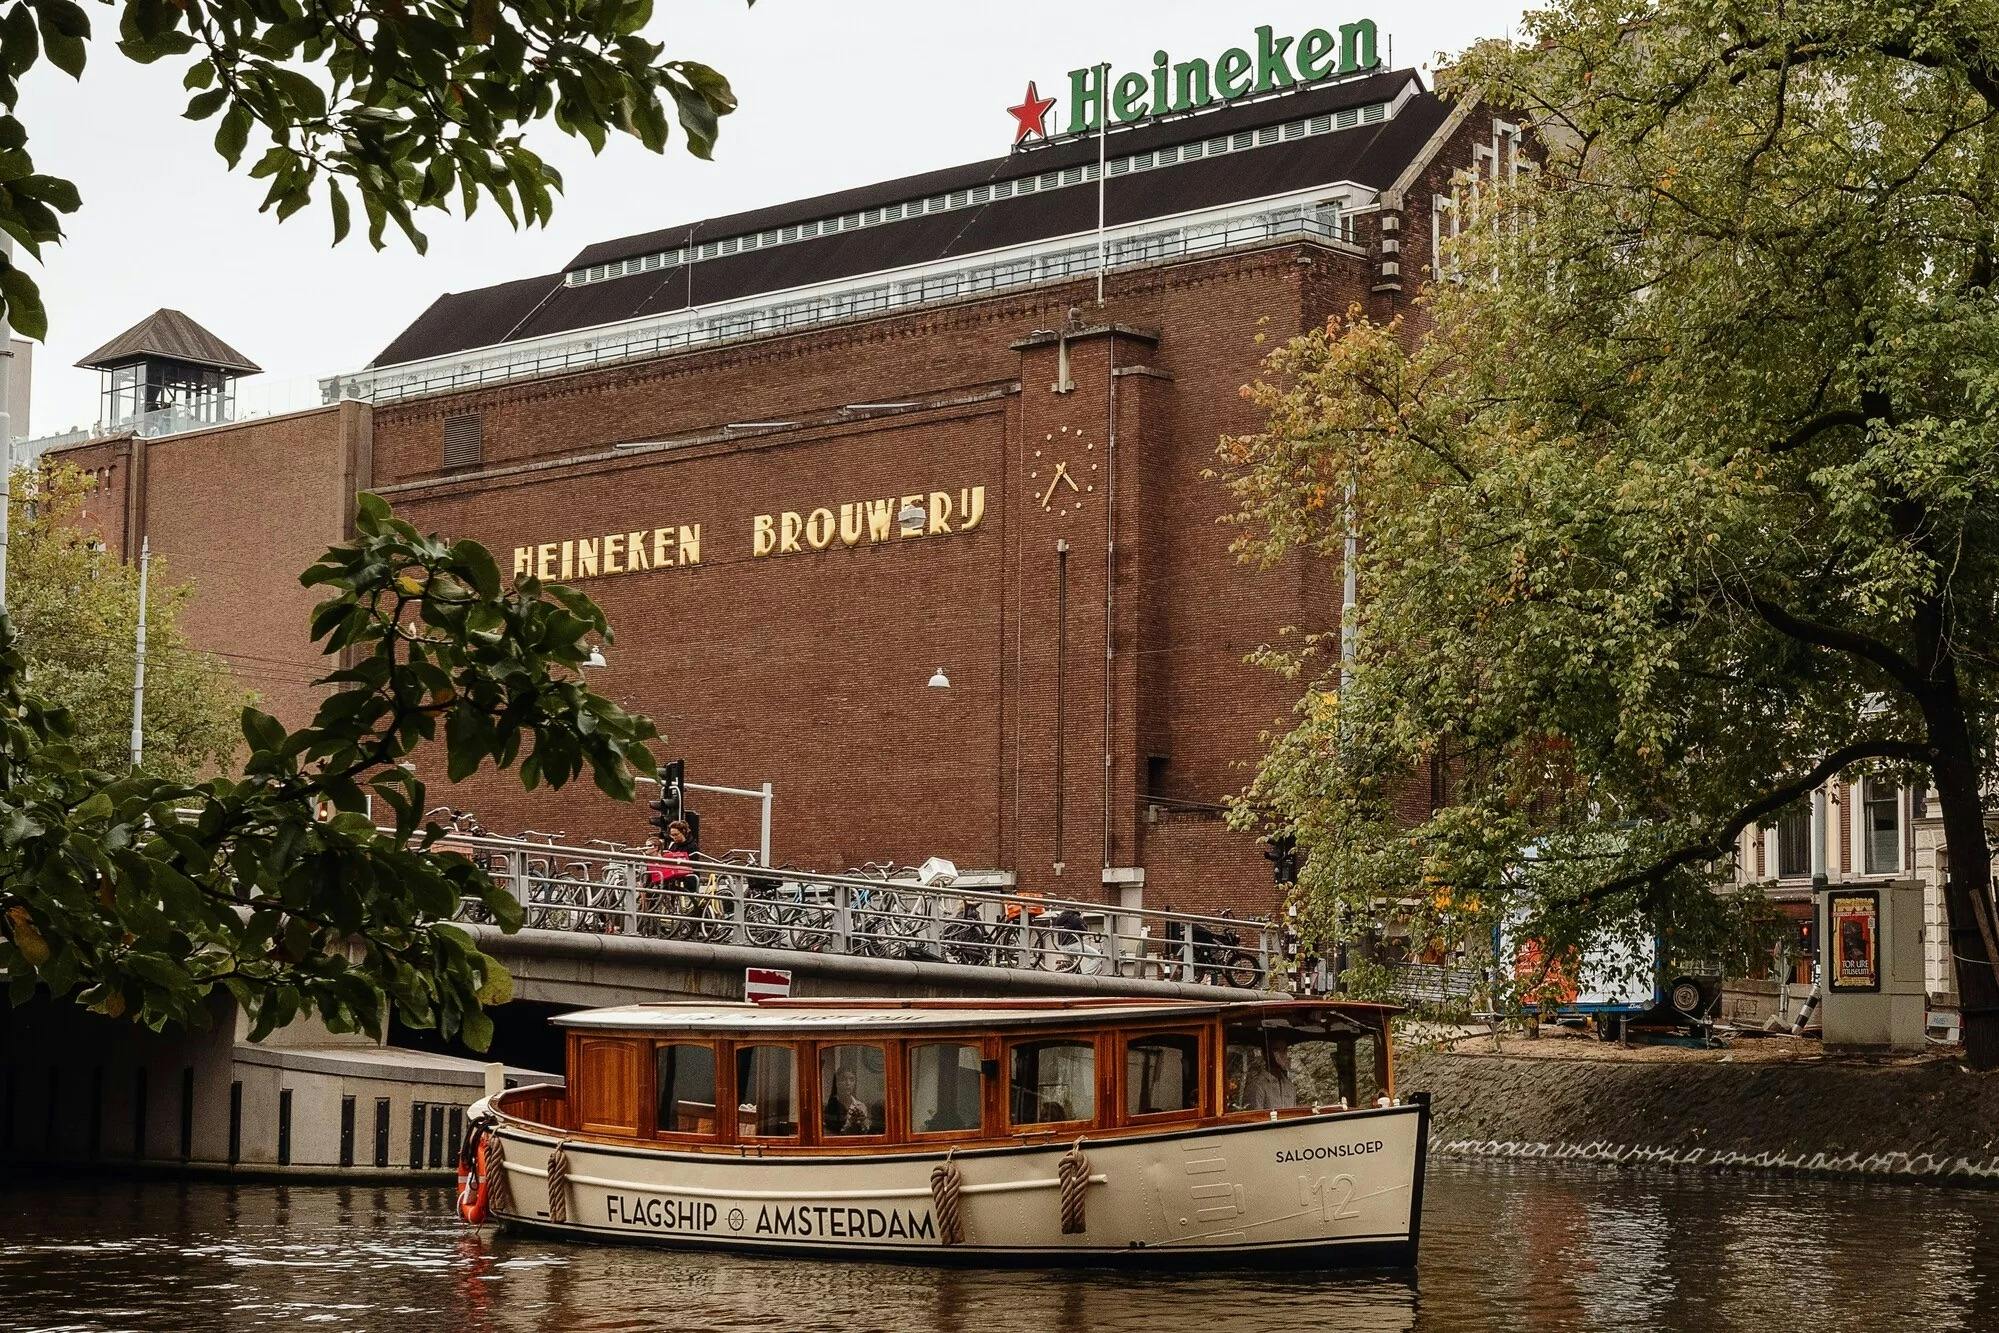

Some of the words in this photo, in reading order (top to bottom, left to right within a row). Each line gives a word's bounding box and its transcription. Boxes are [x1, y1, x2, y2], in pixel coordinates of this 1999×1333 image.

[1067, 18, 1382, 133] Heineken
[513, 523, 701, 582] HEINEKEN
[753, 486, 985, 557] BROUWERIJ
[1841, 959, 1869, 968] TORURE
[1275, 1140, 1384, 1163] SALOONSLOEP
[606, 1195, 717, 1231] FLAGSHIP
[755, 1204, 936, 1239] AMSTERDAM
